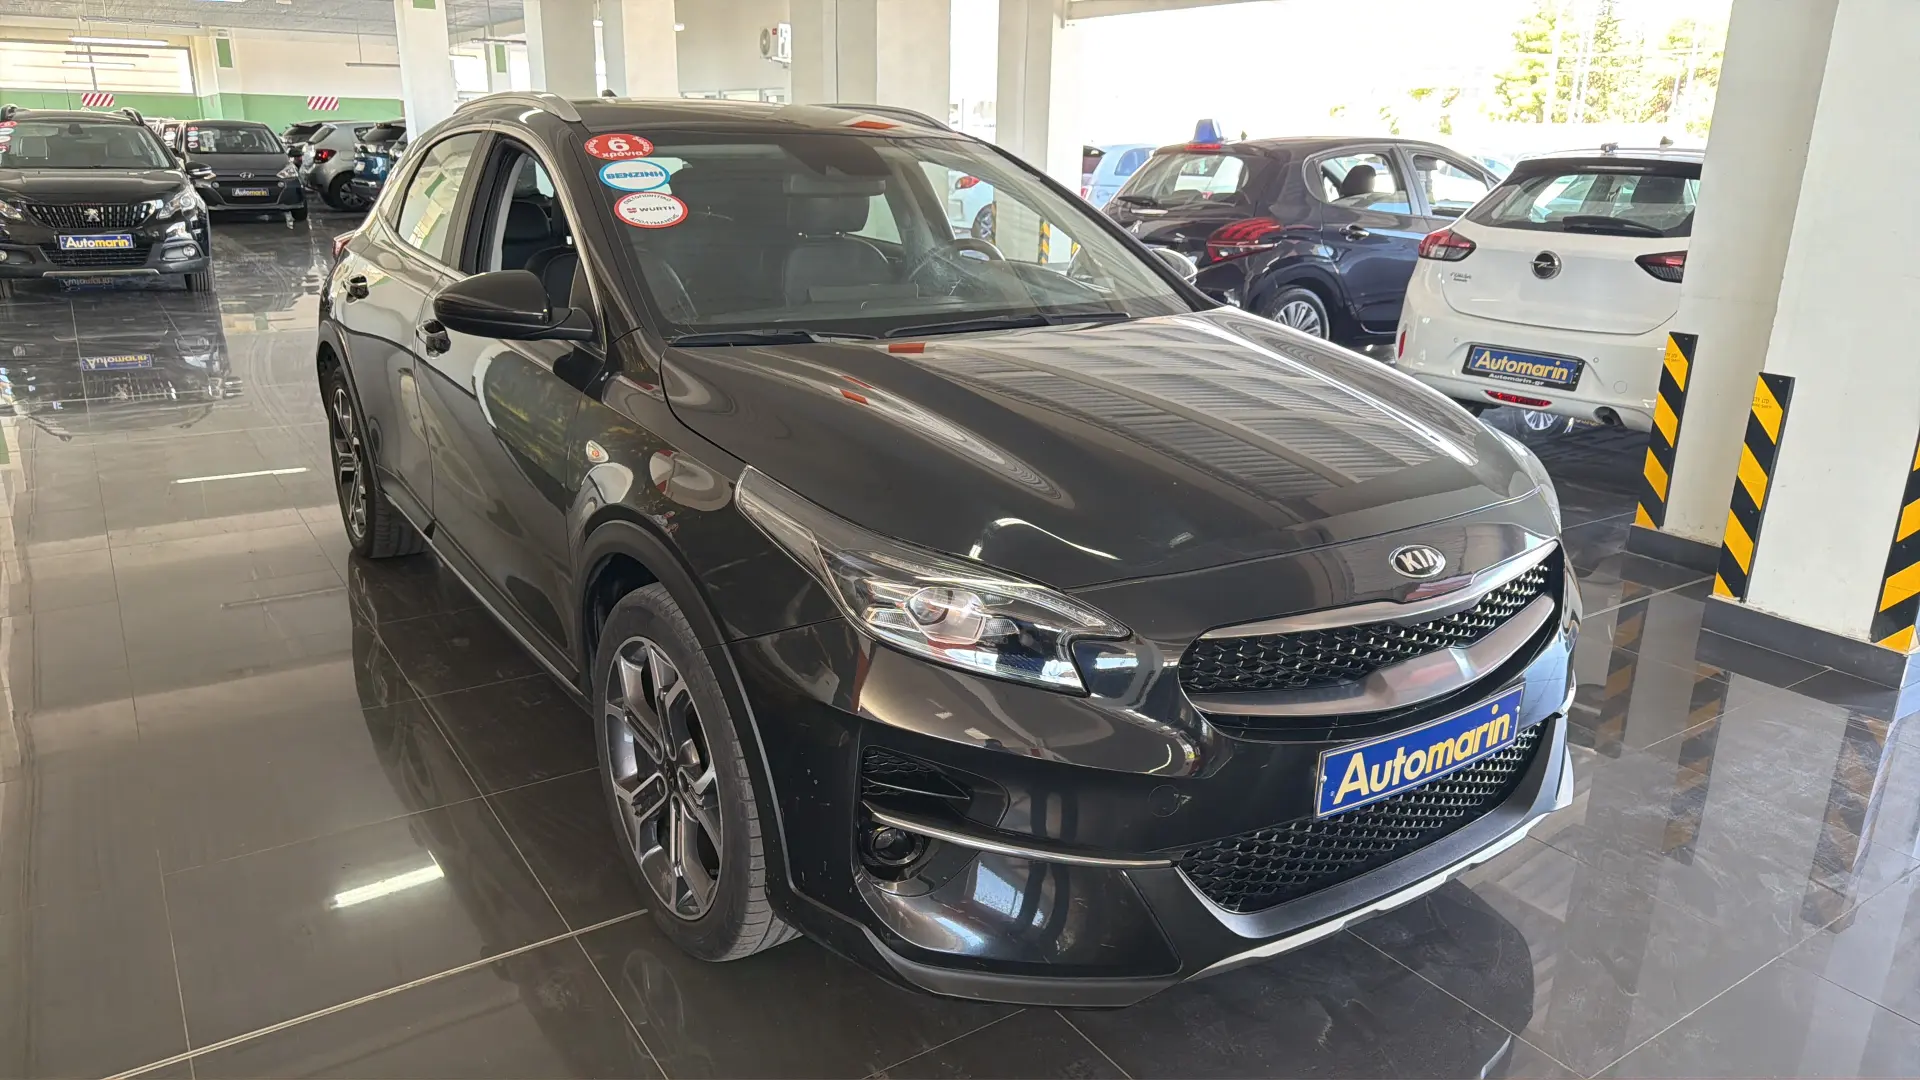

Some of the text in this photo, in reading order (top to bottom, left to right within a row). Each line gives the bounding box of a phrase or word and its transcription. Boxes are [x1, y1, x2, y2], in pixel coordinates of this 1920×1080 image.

[607, 138, 630, 152] 6
[601, 150, 643, 159] χρόνια
[234, 188, 267, 196] Automarin
[65, 235, 129, 248] Automarin
[1474, 351, 1569, 381] Automarin
[1488, 372, 1545, 387] Automarin.gr
[1398, 549, 1440, 573] KIA
[1333, 704, 1511, 805] Automarin
